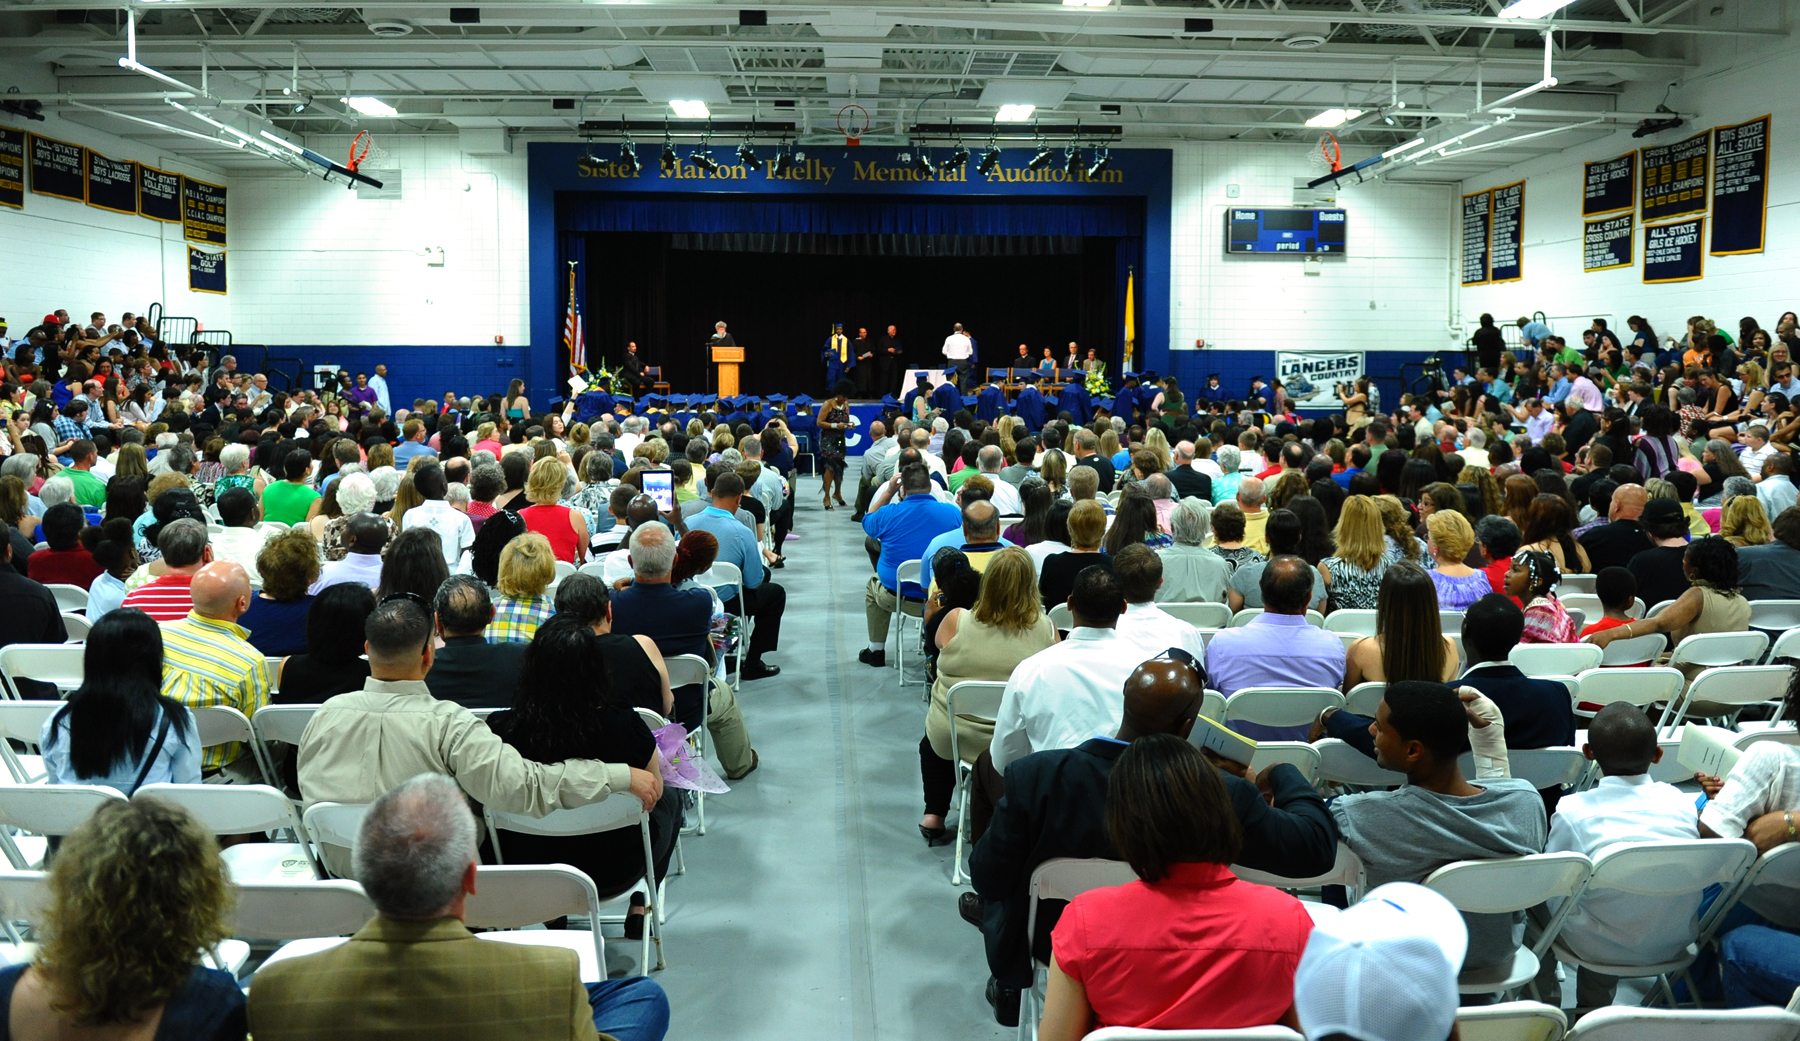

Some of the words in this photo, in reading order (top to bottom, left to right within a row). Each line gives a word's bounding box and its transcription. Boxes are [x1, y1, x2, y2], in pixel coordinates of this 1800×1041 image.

[1720, 130, 1736, 142] BOYS
[1738, 122, 1764, 138] SOCCER
[36, 138, 79, 157] ALL-STATE
[1646, 148, 1668, 158] CROSS
[1672, 136, 1706, 153] COUNTRY
[1717, 135, 1764, 155] ALL-STATE
[36, 148, 50, 160] BOYS
[52, 152, 78, 167] LACROSSE
[1674, 145, 1706, 162] CHAMPIONS
[94, 166, 106, 176] BOYS
[108, 168, 131, 182] LACROSSE
[578, 160, 643, 178] Sister
[659, 158, 748, 179] Marion
[853, 160, 967, 182] Memorial
[987, 162, 1123, 182] Auditorium
[1588, 174, 1600, 184] BOYS
[1601, 172, 1609, 181] ICE
[1610, 168, 1630, 180] HOCKEY
[1590, 164, 1606, 174] STATE
[144, 170, 177, 186] ALL-STATE
[144, 178, 176, 194] VOLLEYBALL
[1672, 176, 1704, 192] CHAMPIONS
[1235, 210, 1256, 220] Home
[1318, 212, 1344, 221] Guests
[1587, 216, 1630, 233] ALL-STATE
[1651, 223, 1697, 238] ALL-STATE
[1586, 232, 1604, 243] CROSS
[1604, 228, 1630, 240] COUNTRY
[1648, 237, 1664, 249] GIRLS
[1664, 236, 1674, 247] ICE
[1675, 233, 1698, 246] HOCKEY
[1276, 242, 1300, 250] period
[191, 250, 224, 261] ALL-STATE
[200, 260, 217, 268] GOLF
[1282, 356, 1358, 376] LANCERS
[1310, 368, 1358, 380] COUNTRY
